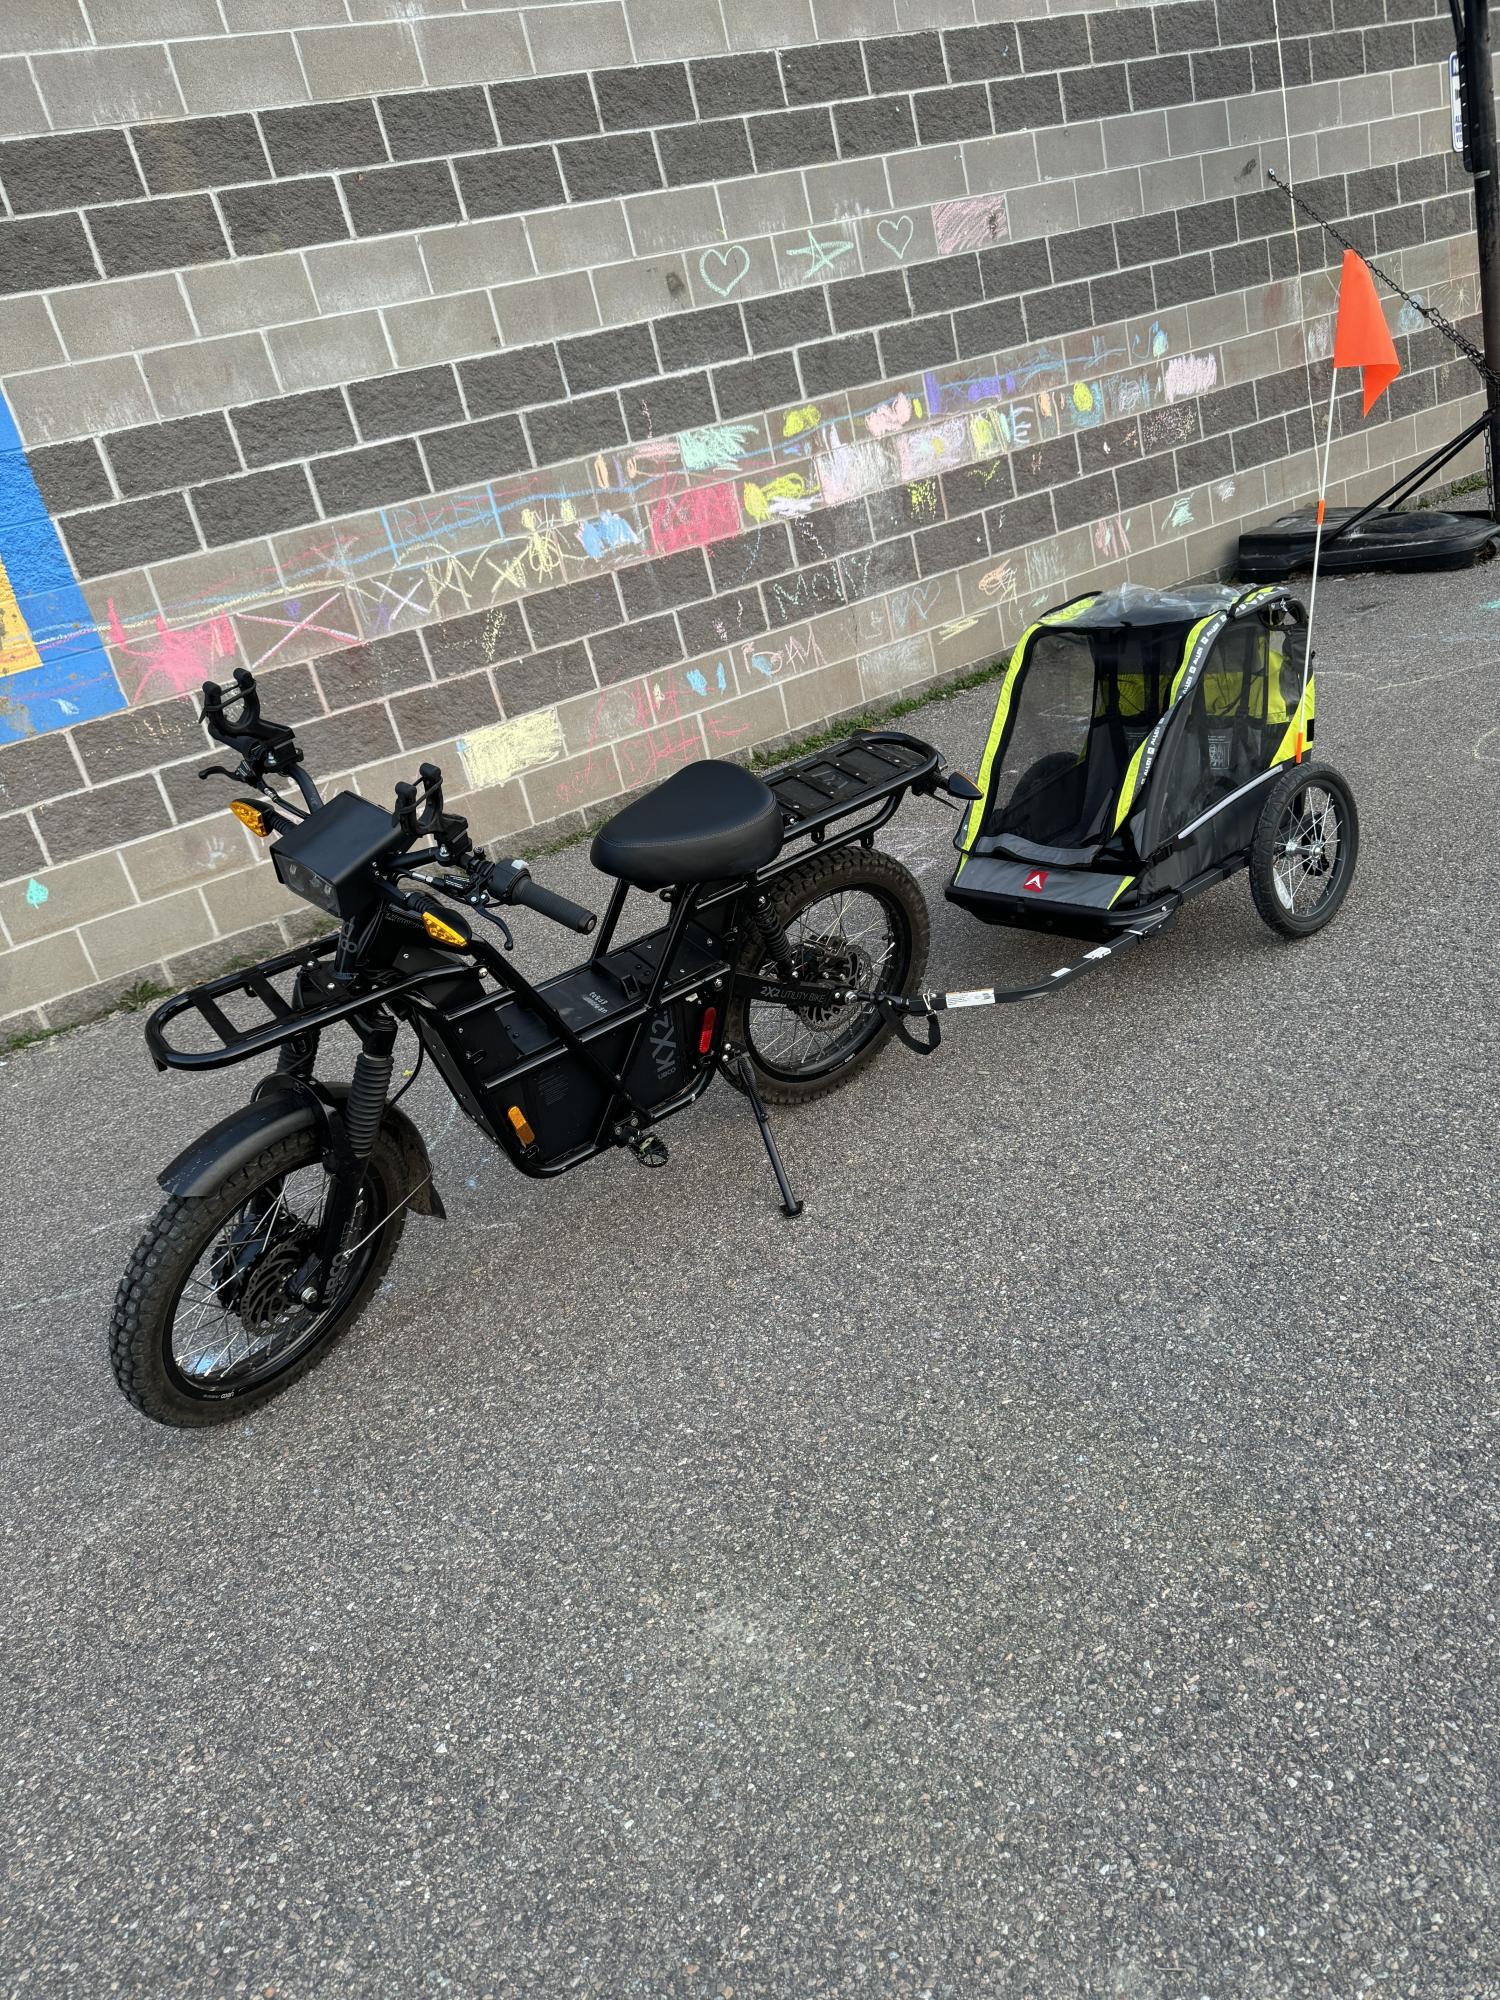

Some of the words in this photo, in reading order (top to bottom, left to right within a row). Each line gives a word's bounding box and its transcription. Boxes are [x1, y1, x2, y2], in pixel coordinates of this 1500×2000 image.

[1206, 621, 1220, 637] ALLEN
[1192, 646, 1204, 665] ALLEN
[1182, 676, 1193, 694] ALLEN
[1150, 726, 1161, 745] ALLEN
[1143, 757, 1153, 776] ALLEN
[760, 986, 780, 998] 2X2
[781, 990, 808, 1000] UTILITY
[809, 993, 826, 1001] BIKE
